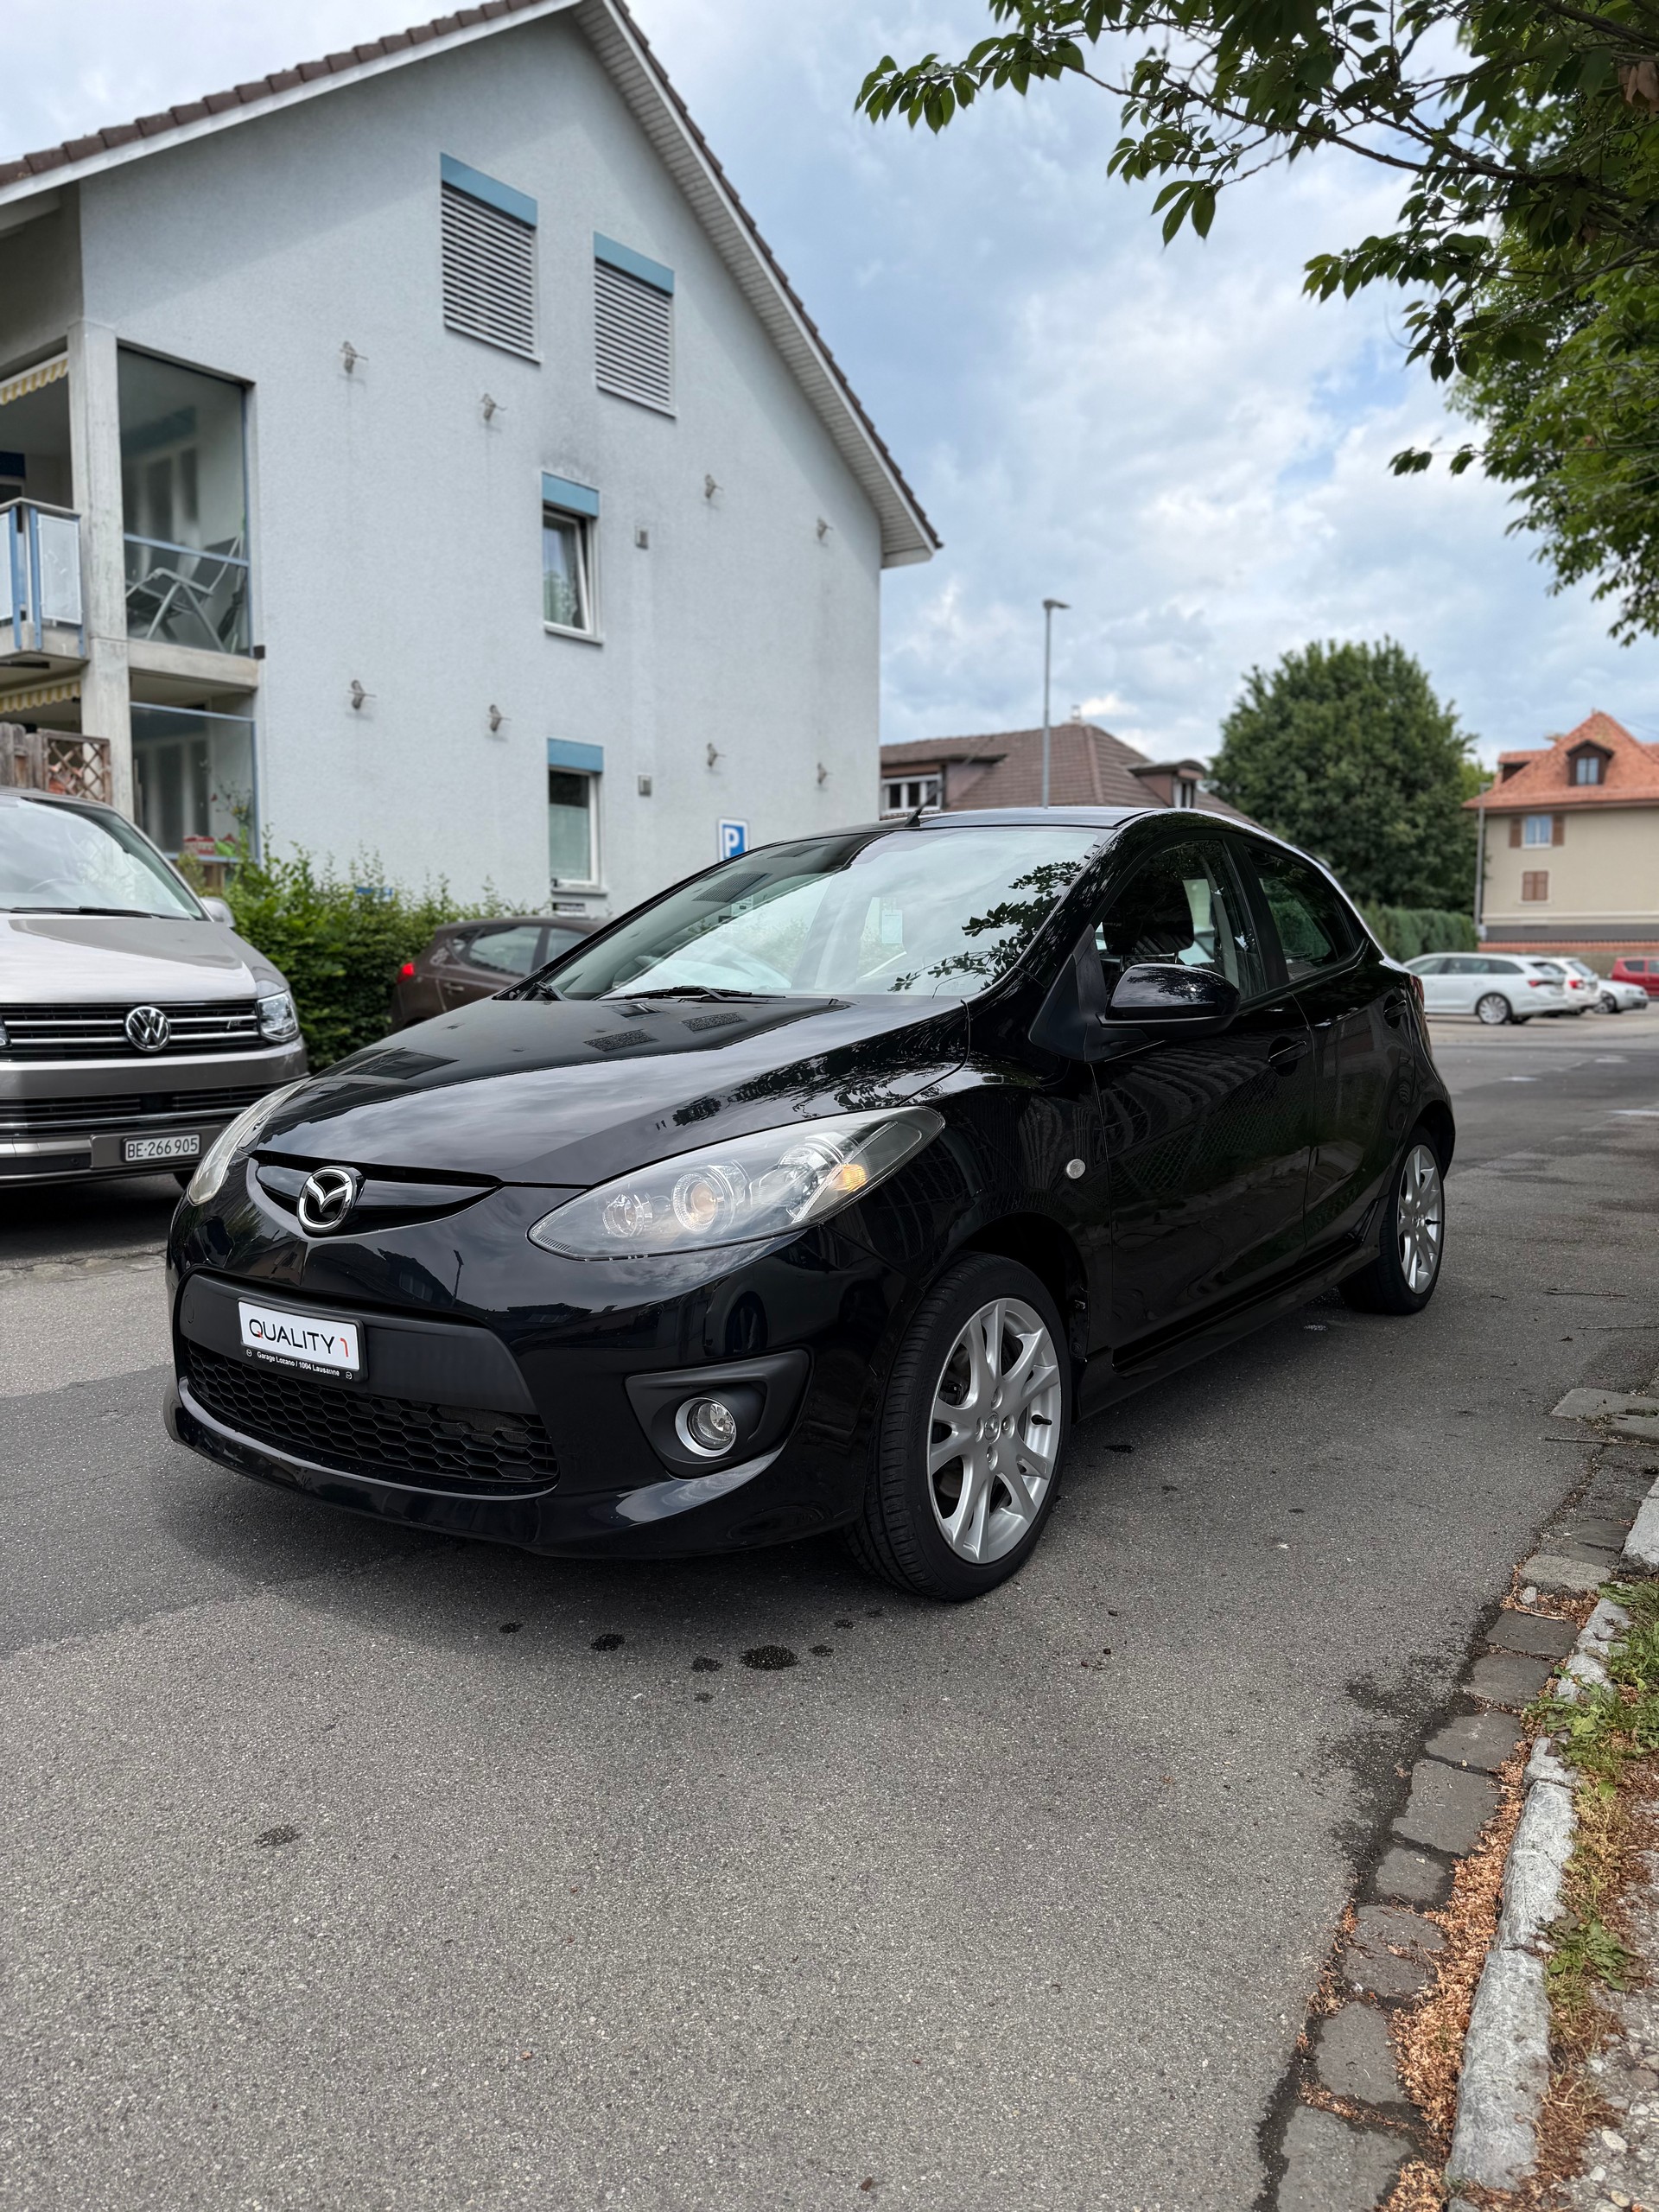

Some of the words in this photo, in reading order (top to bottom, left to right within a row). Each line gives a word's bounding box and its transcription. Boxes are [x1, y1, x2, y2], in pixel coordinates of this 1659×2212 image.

[724, 827, 740, 858] P
[257, 1351, 275, 1363] Garage
[276, 1356, 296, 1367] Lozano
[312, 1364, 340, 1376] Lausanne
